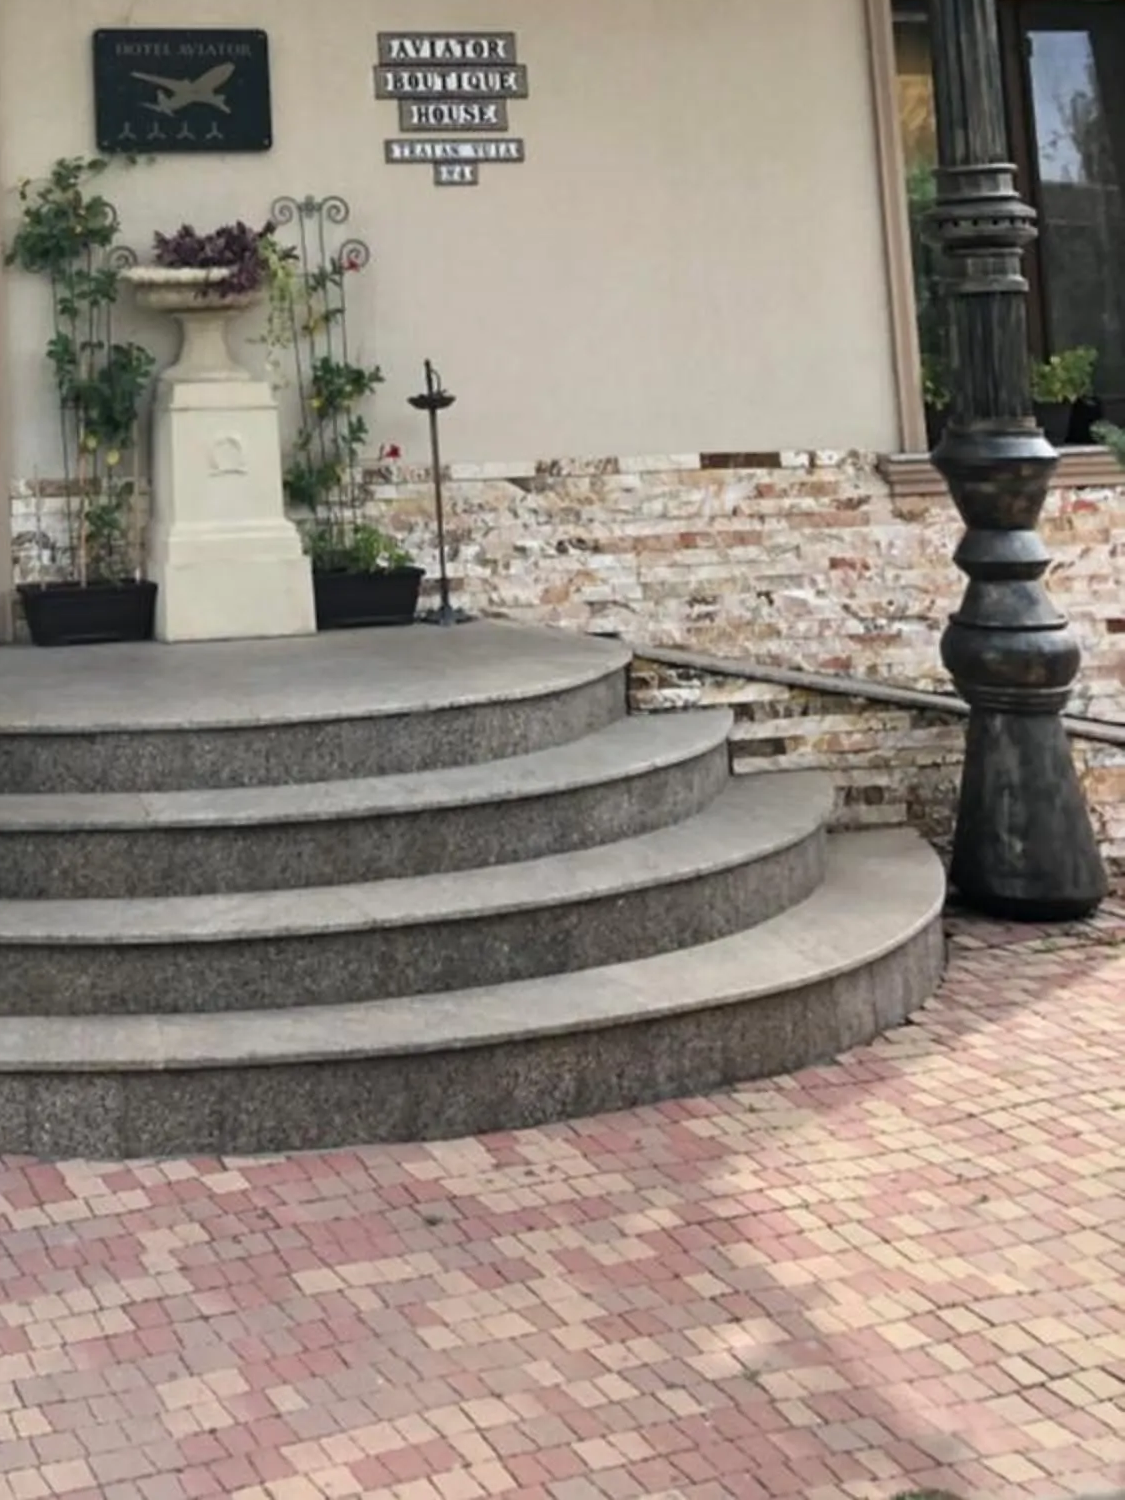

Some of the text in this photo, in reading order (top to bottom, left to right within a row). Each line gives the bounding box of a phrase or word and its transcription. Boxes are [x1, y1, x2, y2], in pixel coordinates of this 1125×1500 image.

[115, 42, 252, 58] HOTEL AVIATOR
[391, 39, 504, 58] AVIATOR
[389, 72, 516, 91] BOUTIQUE
[413, 105, 496, 123] HOUSE
